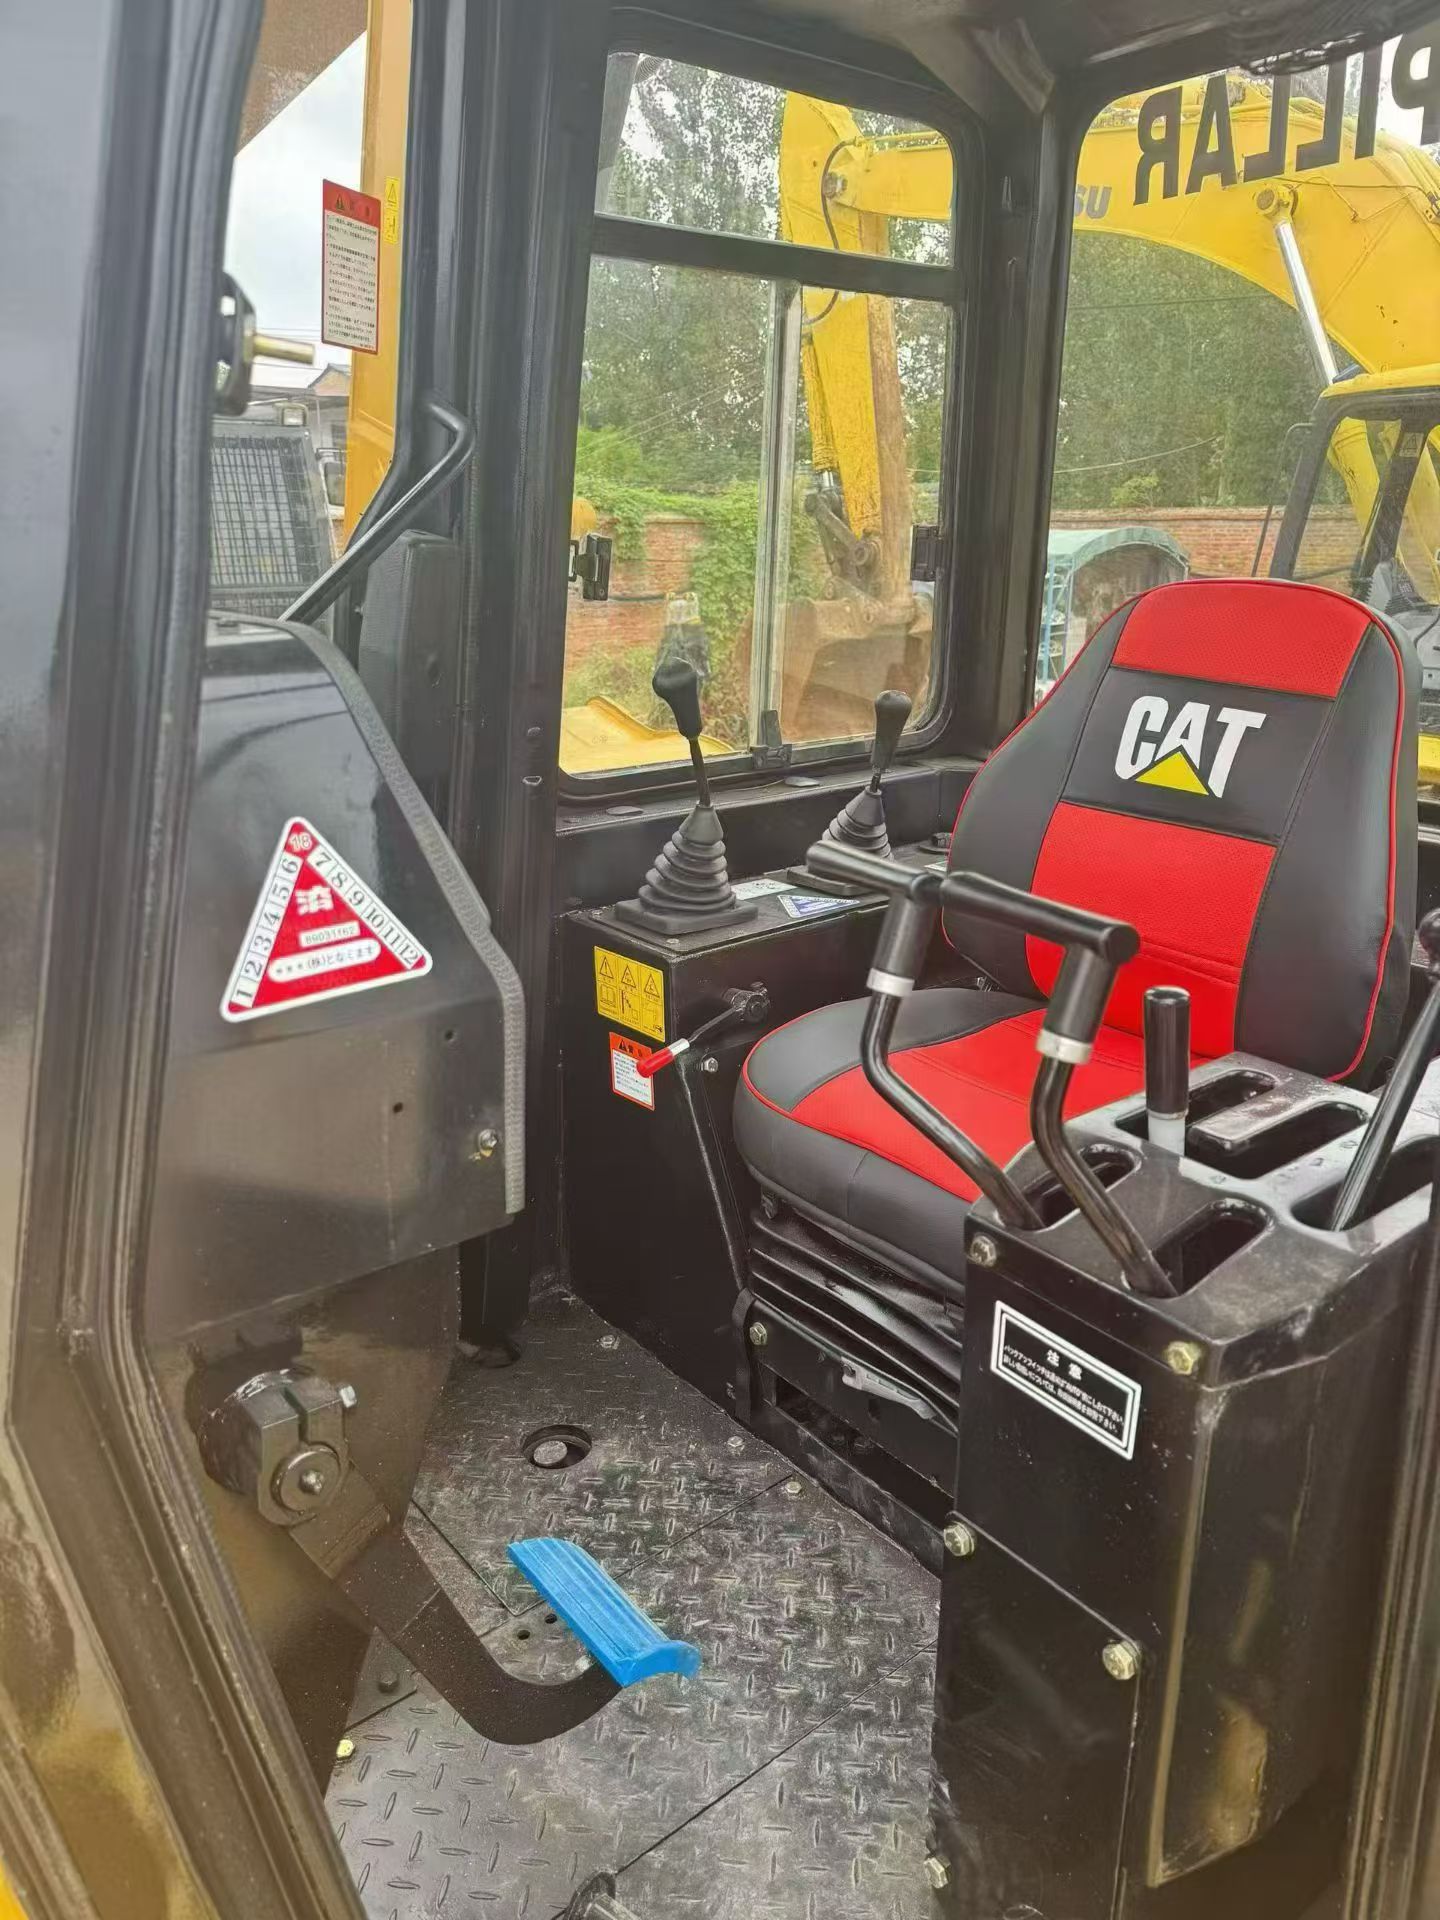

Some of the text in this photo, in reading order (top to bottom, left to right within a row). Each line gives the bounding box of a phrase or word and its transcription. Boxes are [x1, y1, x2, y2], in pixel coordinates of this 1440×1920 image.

[1115, 695, 1267, 799] CAT
[289, 833, 313, 851] 18
[236, 859, 298, 999] 1 2 3 4 5 6
[315, 851, 420, 964] 7 8 9 10 11 12
